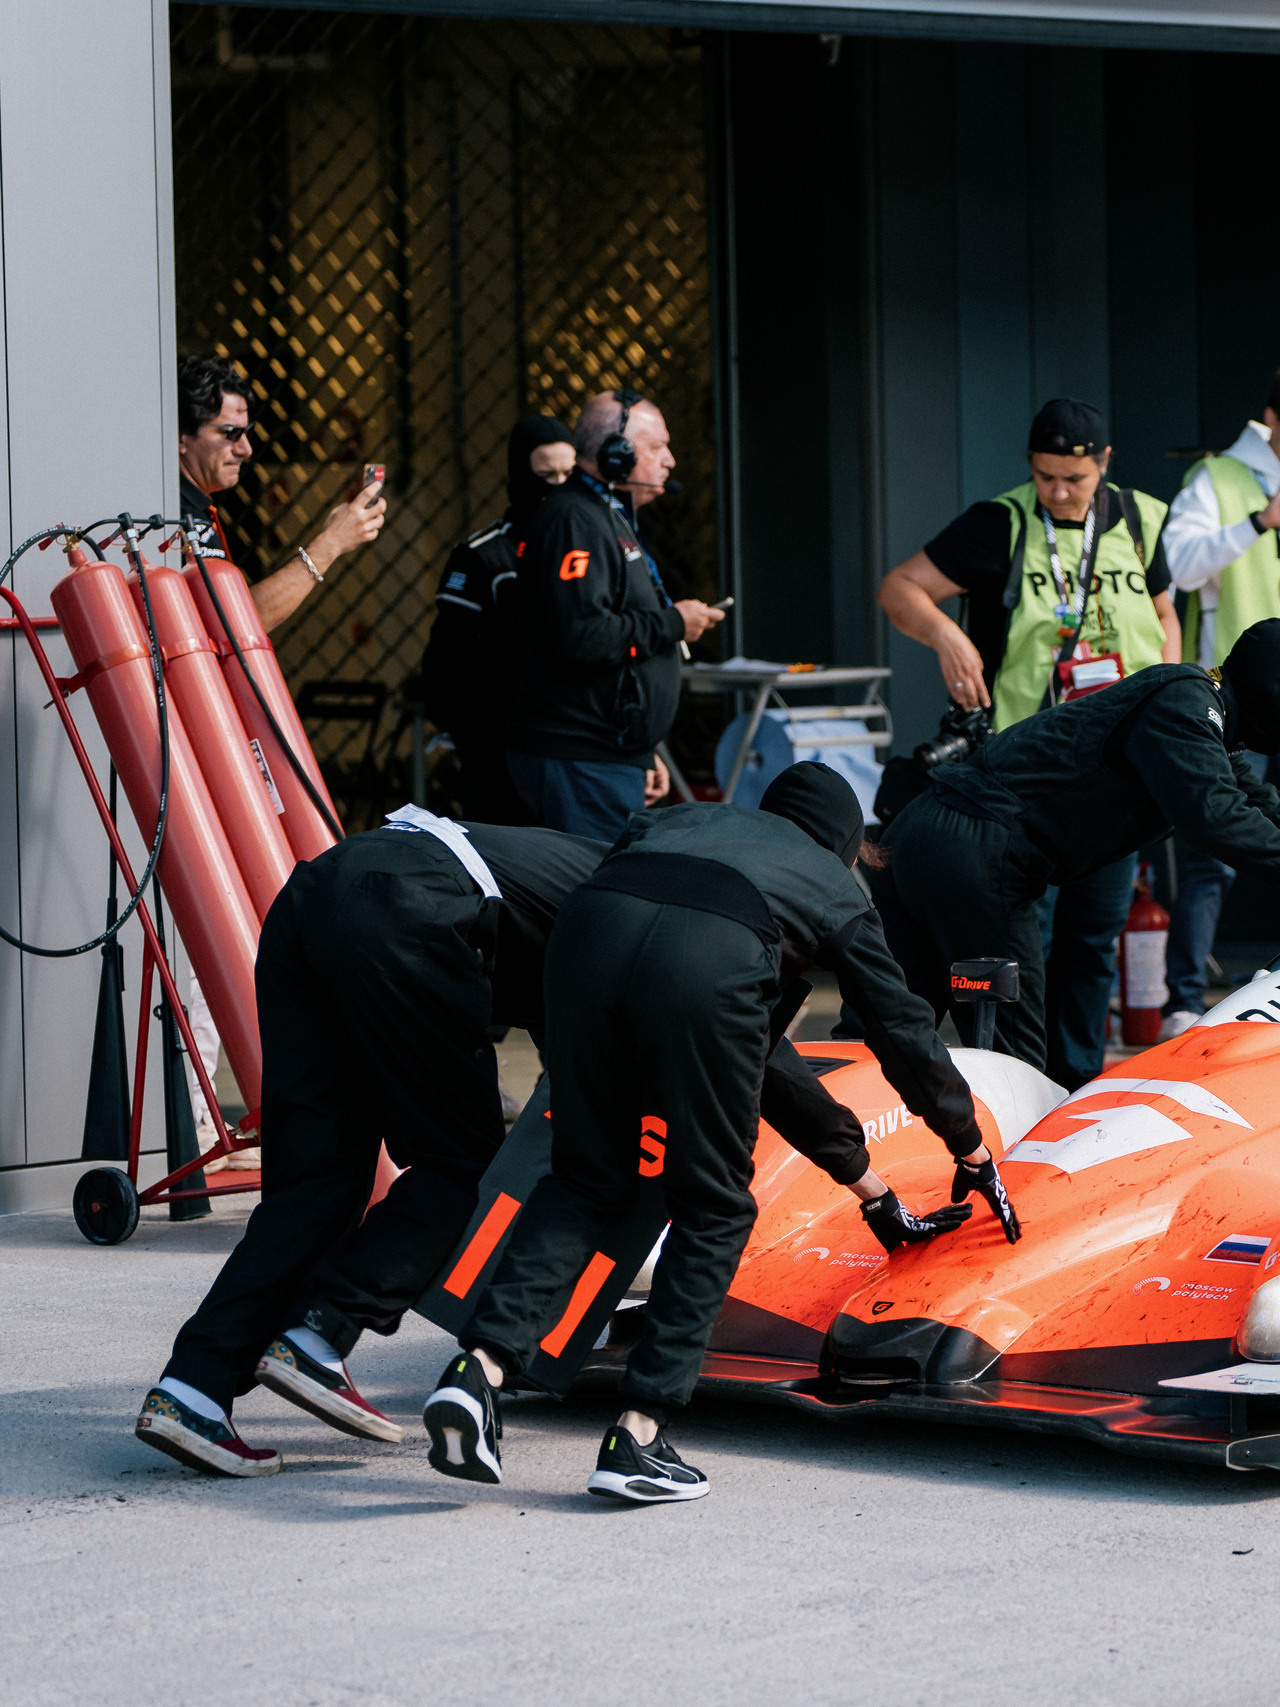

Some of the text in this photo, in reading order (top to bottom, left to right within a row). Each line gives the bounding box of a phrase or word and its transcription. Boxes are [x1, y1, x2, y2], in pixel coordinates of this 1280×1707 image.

[951, 976, 991, 990] G-DRIVE
[1181, 1283, 1237, 1293] moscow
[1171, 1289, 1229, 1301] polytech
